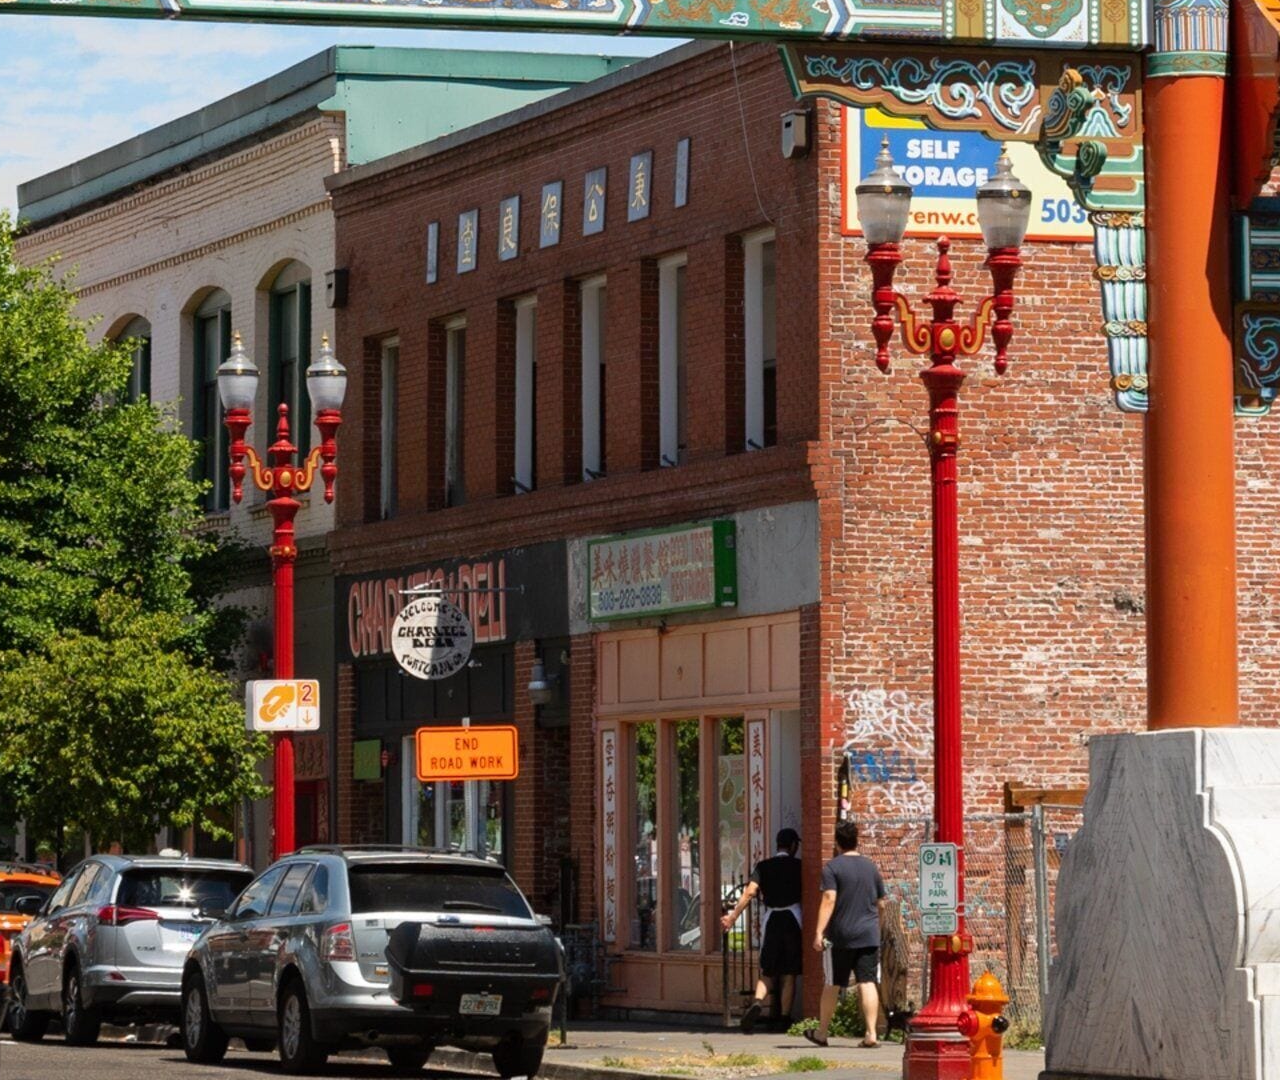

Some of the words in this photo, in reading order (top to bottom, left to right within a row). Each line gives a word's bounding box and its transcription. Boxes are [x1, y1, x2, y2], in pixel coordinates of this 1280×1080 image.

[906, 138, 961, 160] SELF
[892, 164, 989, 187] TORAGE
[1041, 198, 1086, 224] 503
[301, 684, 312, 702] 2
[455, 737, 479, 751] END
[430, 756, 463, 770] ROAD
[470, 756, 504, 769] WORK
[931, 872, 945, 881] PAY
[933, 881, 944, 889] TO
[928, 889, 948, 897] PARK
